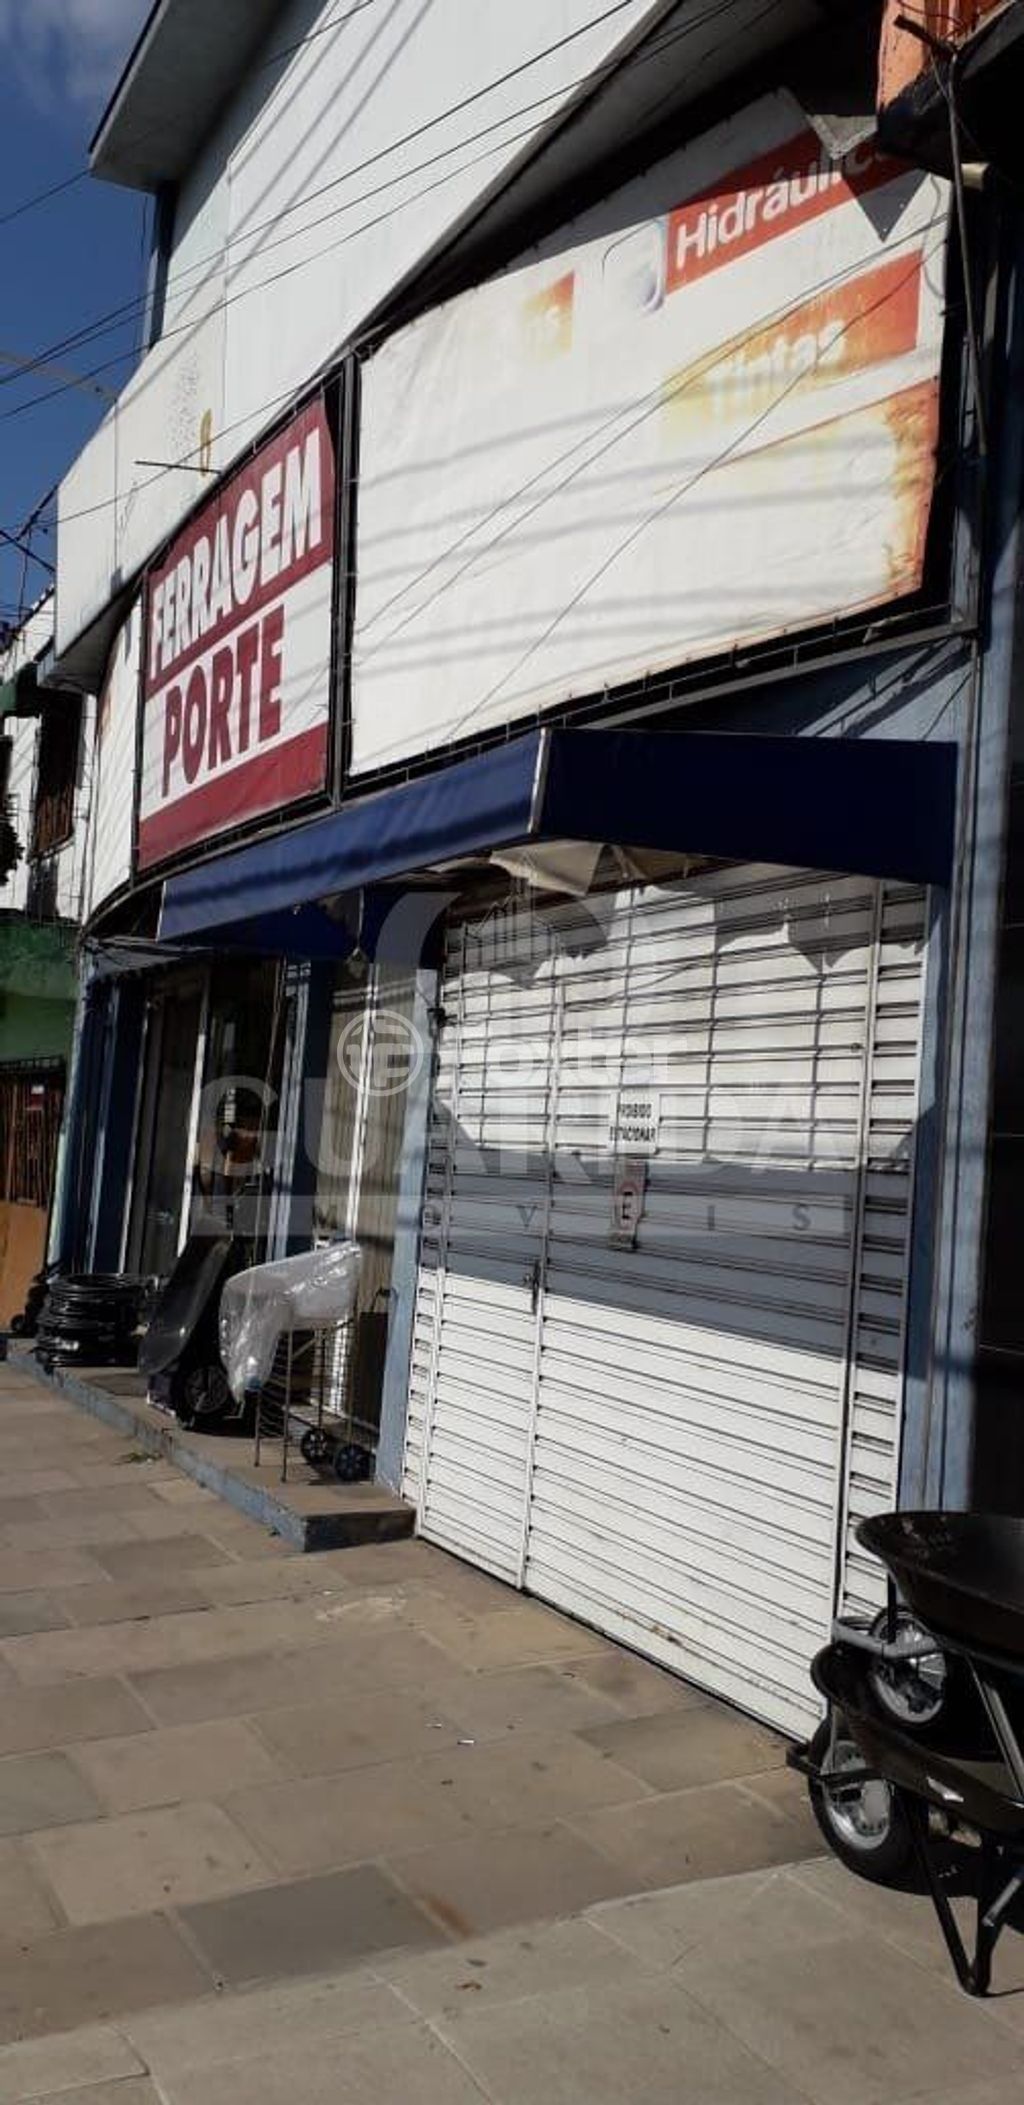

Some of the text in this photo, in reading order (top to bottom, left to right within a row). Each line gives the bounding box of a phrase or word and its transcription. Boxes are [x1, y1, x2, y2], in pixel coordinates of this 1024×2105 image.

[675, 143, 883, 271] Hidráulic
[149, 427, 323, 681] FERRAGEM
[161, 604, 285, 798] PORTE
[621, 1191, 633, 1219] E
